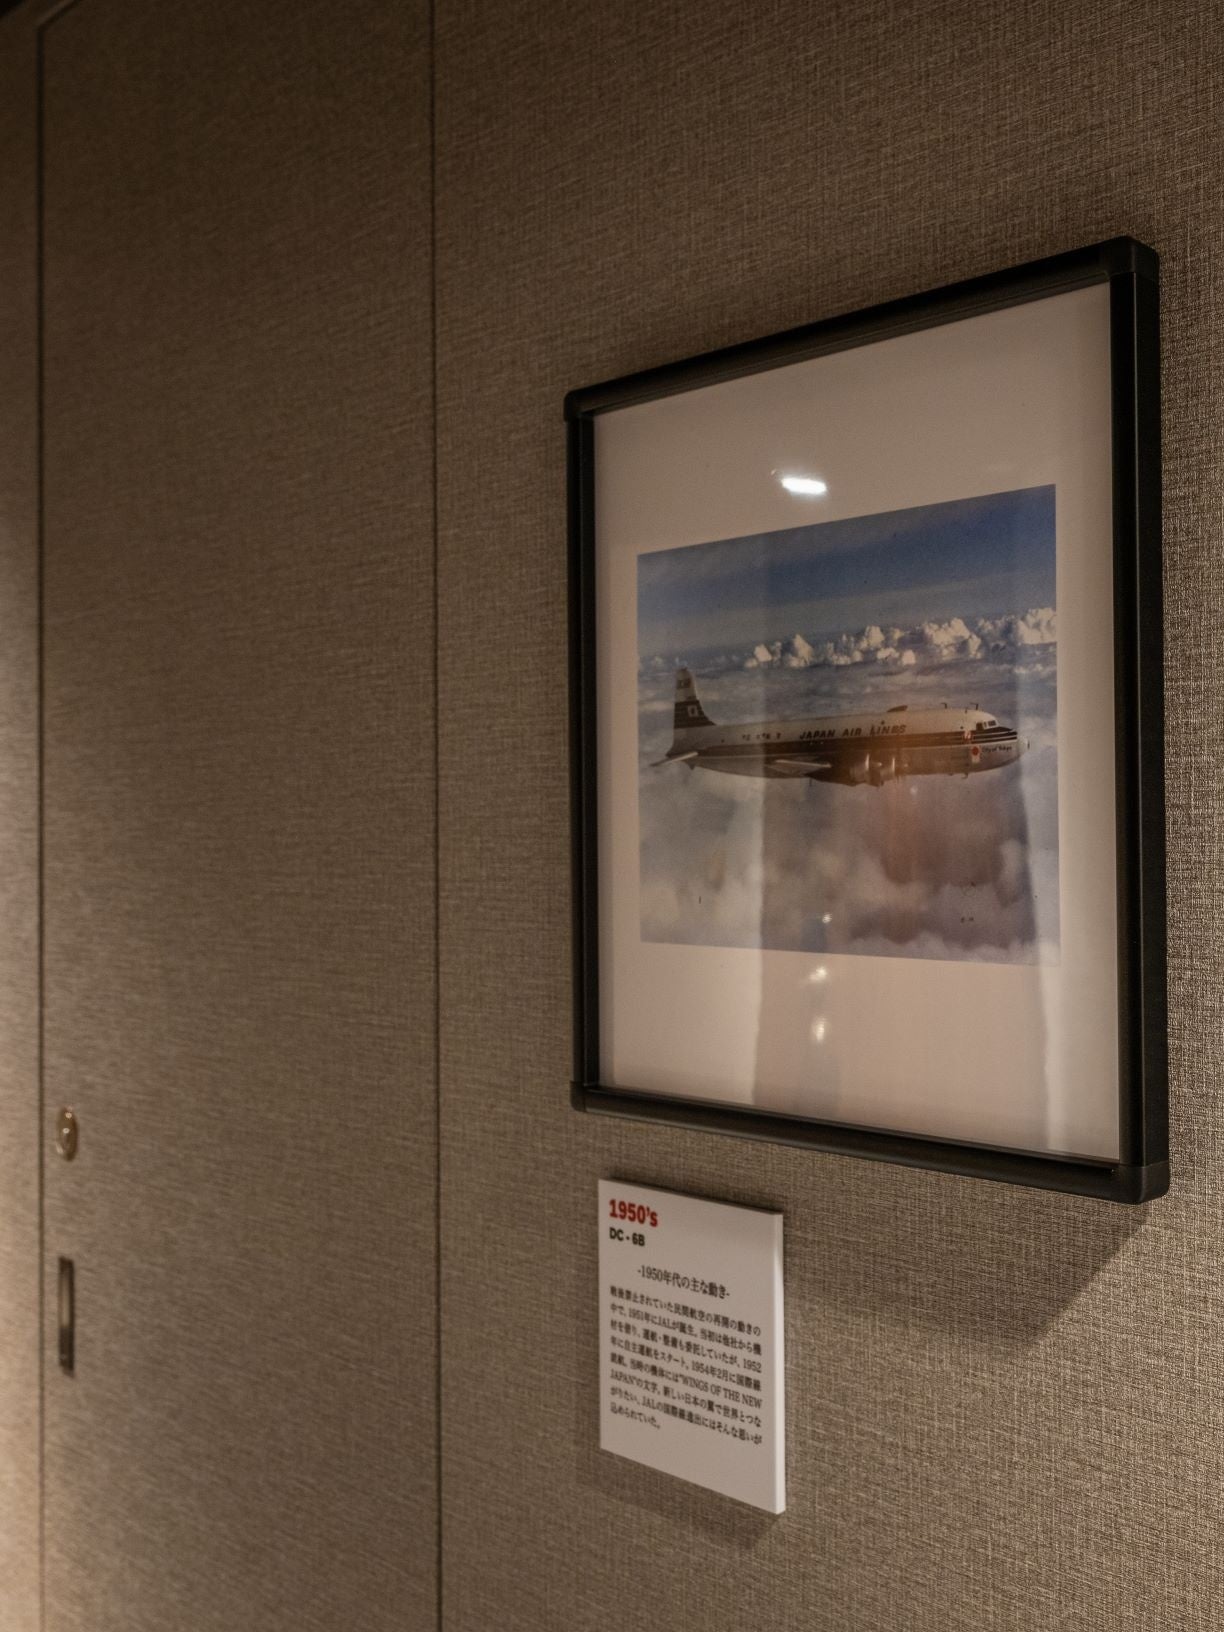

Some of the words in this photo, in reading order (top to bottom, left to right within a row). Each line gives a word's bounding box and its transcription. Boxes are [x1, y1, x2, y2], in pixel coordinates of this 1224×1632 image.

[800, 729, 835, 739] JAPAN
[843, 728, 862, 736] AIR
[609, 1199, 658, 1227] 1950's
[723, 1387, 741, 1403] THE
[741, 1392, 762, 1410] NEW
